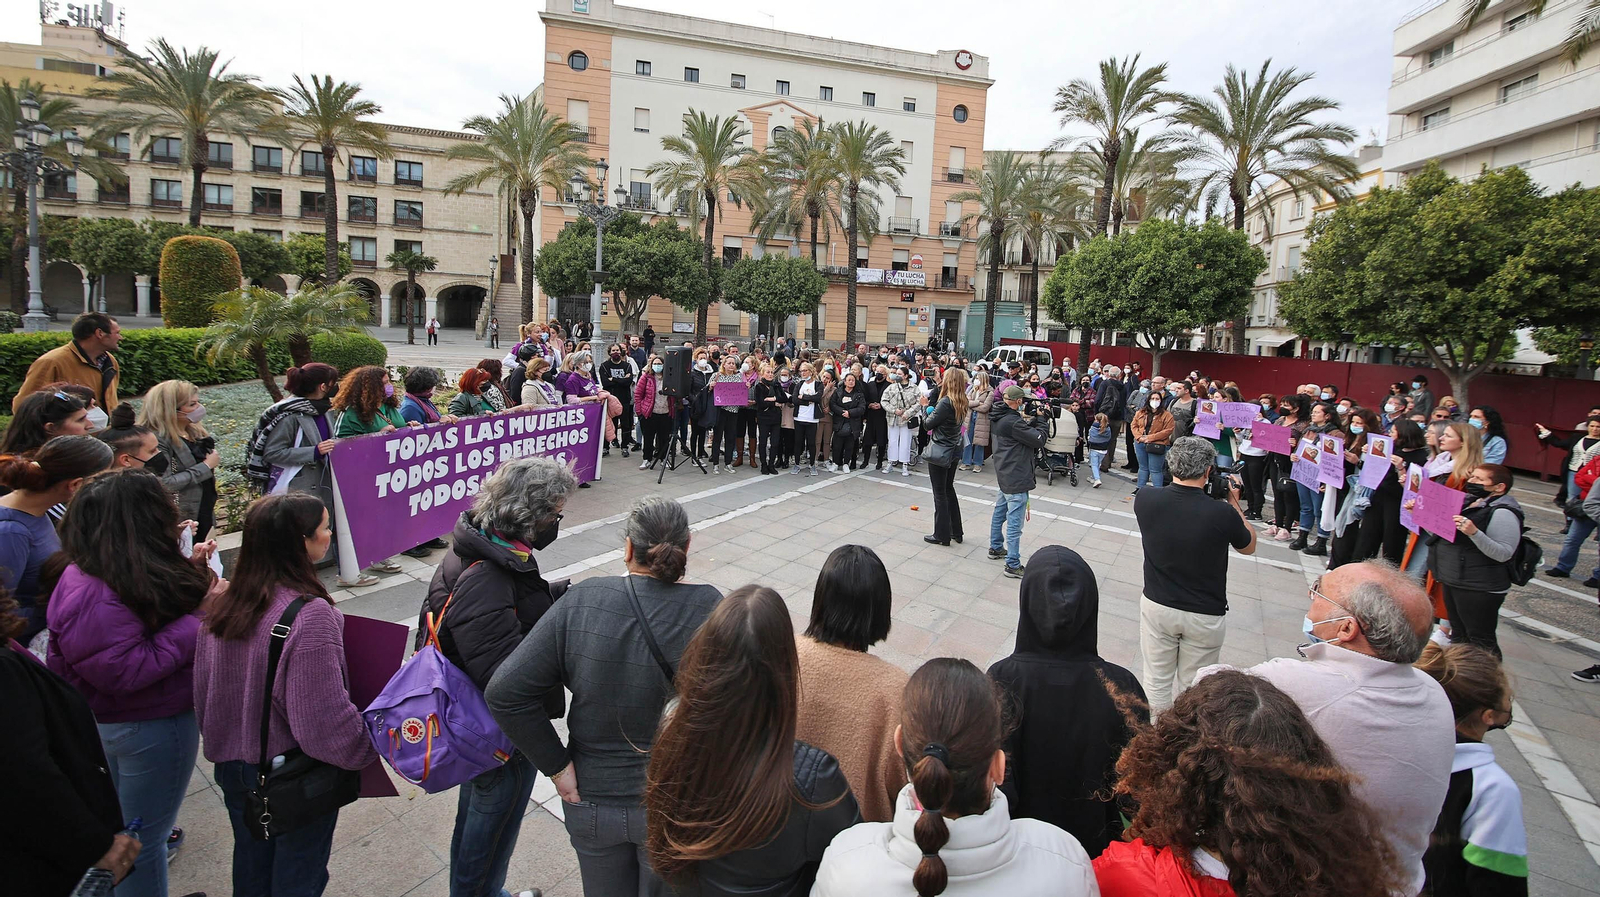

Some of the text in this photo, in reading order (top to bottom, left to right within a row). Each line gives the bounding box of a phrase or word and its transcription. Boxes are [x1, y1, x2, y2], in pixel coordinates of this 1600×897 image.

[375, 456, 449, 498] TODOS
[455, 446, 495, 474] LOS
[500, 428, 589, 462] DERECHOS
[386, 408, 586, 464] TODAS LAS MUJERES
[409, 474, 480, 517] TODOS
